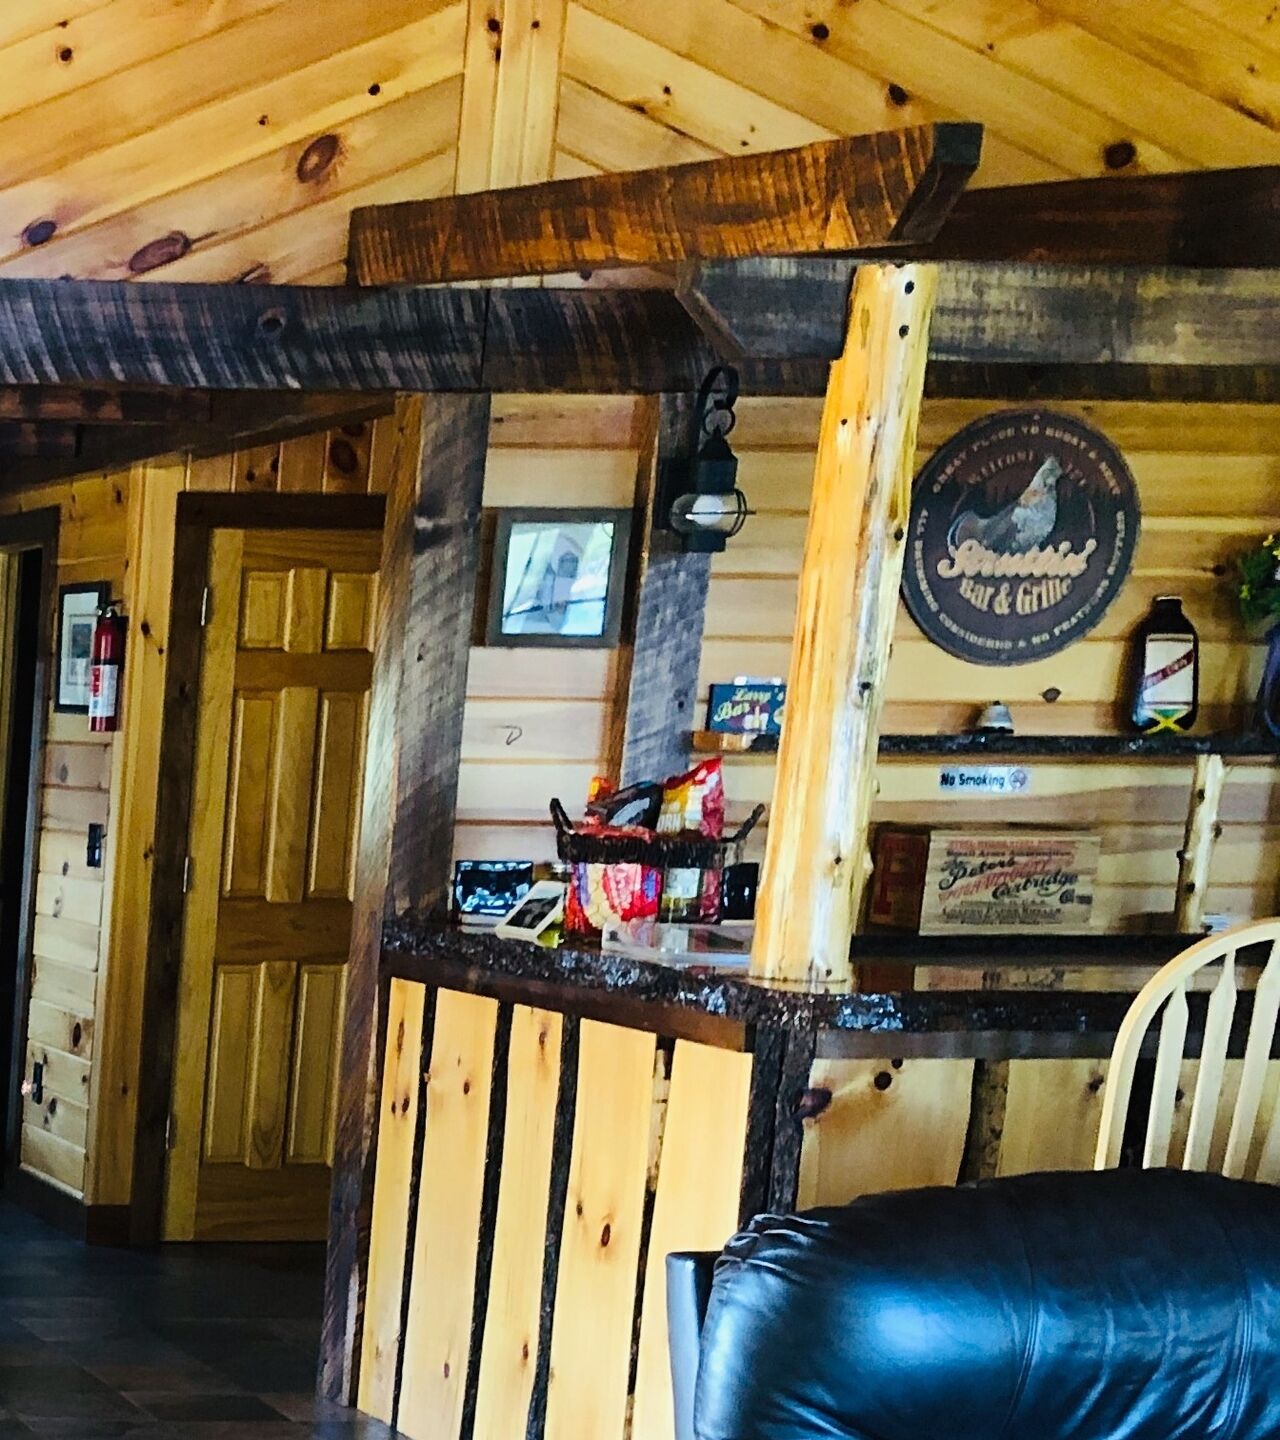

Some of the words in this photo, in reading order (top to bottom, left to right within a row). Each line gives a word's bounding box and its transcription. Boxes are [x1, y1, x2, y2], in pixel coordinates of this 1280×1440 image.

[960, 577, 995, 612] Bar
[993, 582, 1012, 616] &
[1016, 577, 1073, 616] Grille
[940, 773, 956, 786] No
[959, 773, 1006, 789] Smoking
